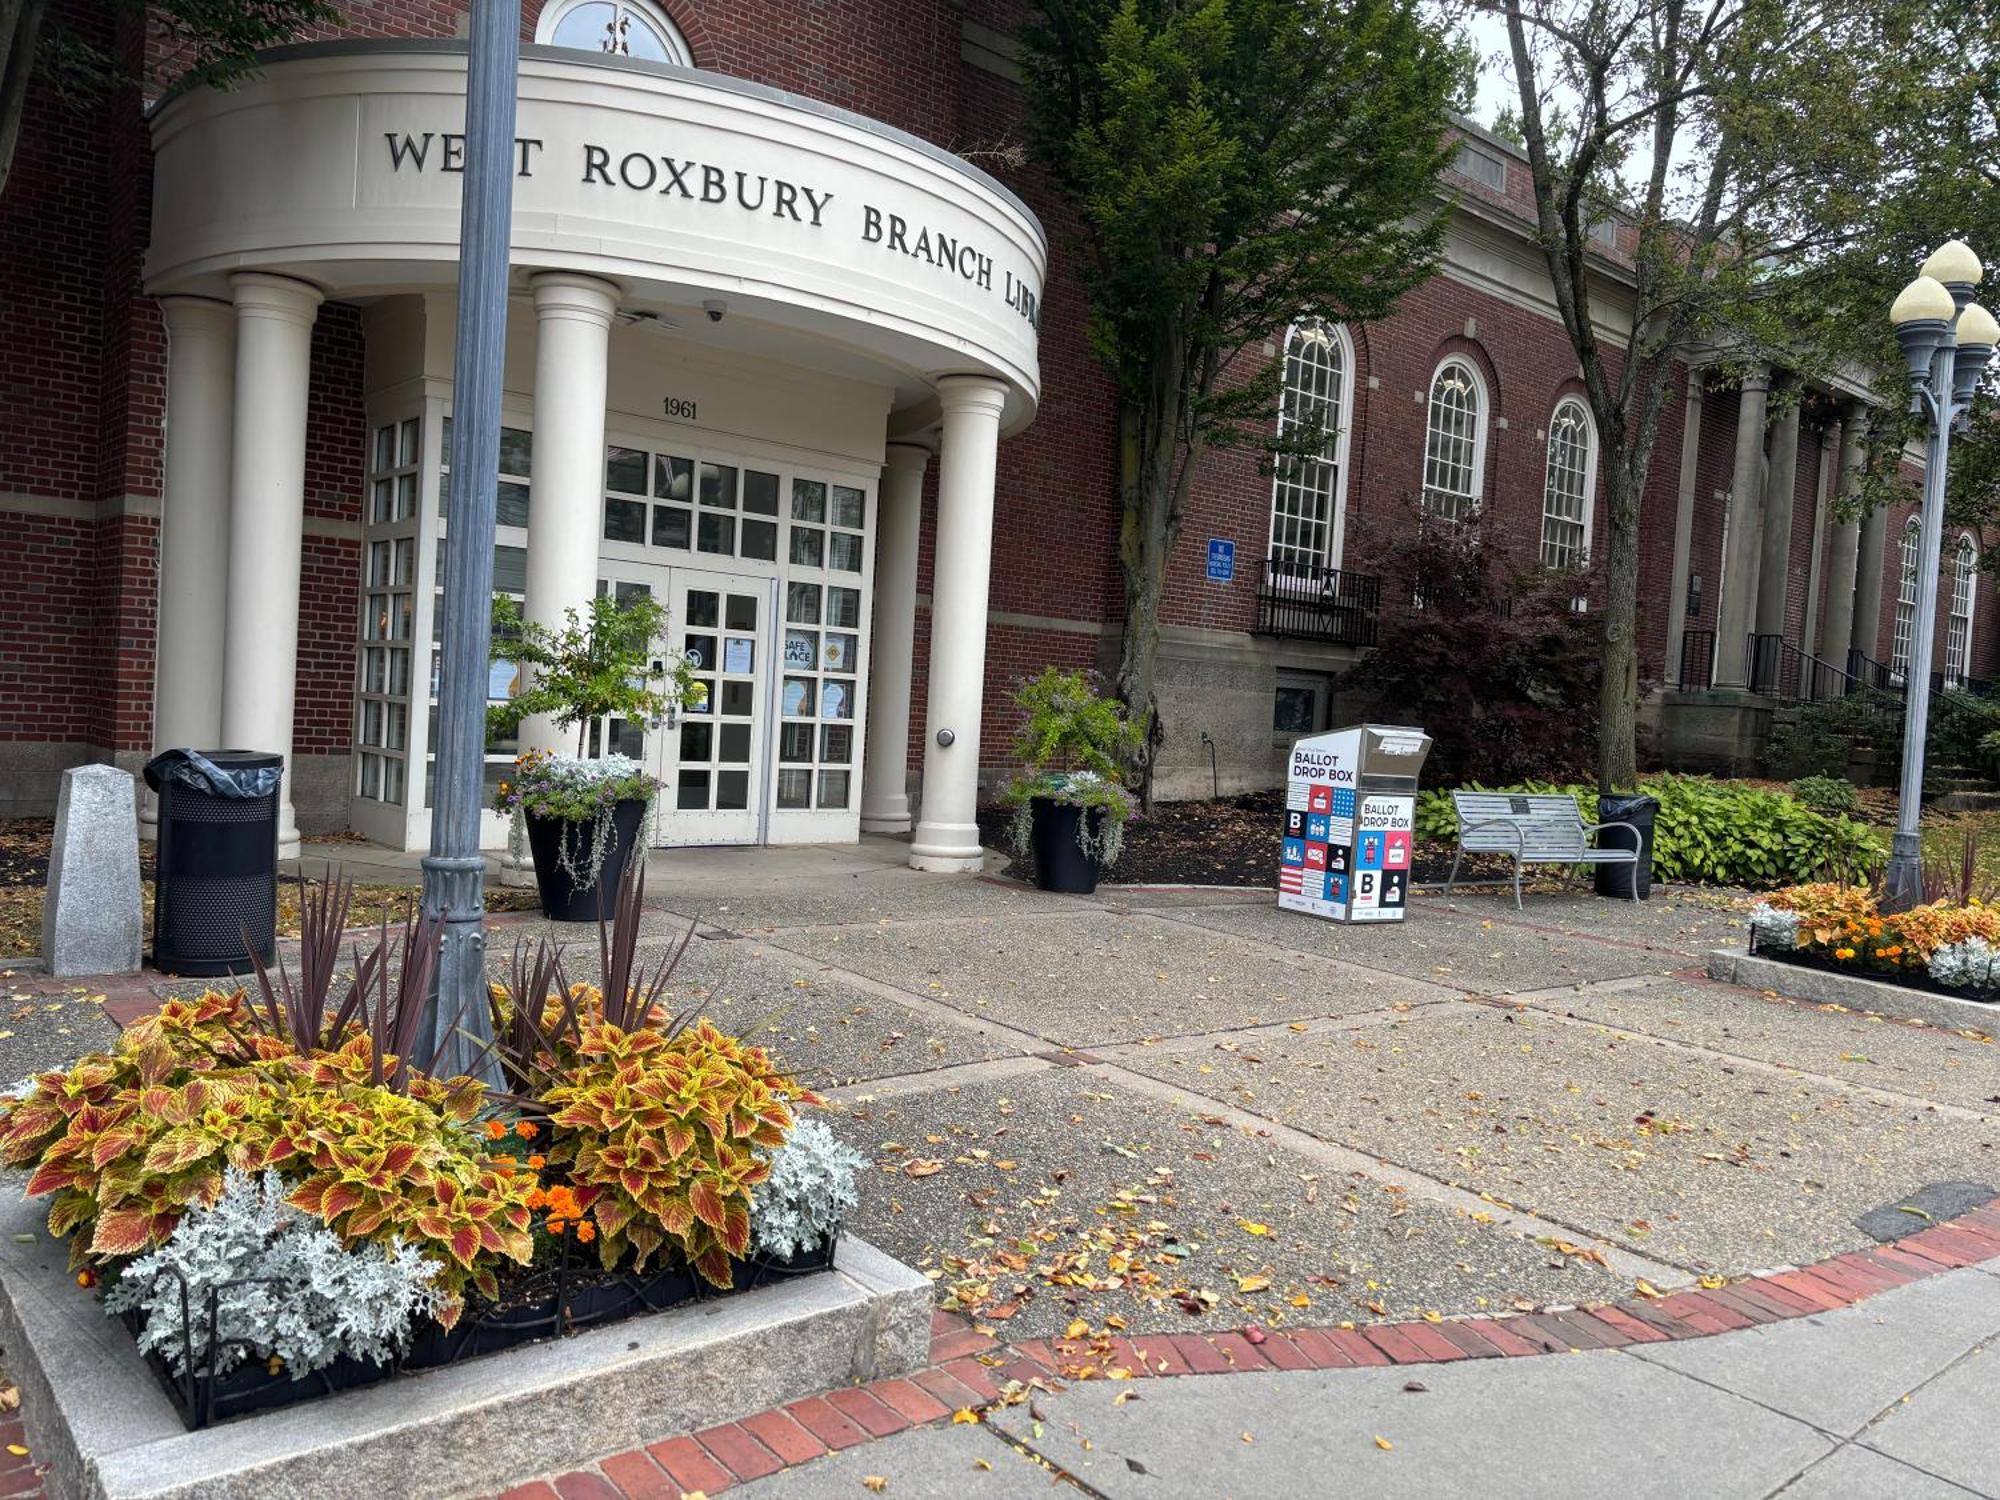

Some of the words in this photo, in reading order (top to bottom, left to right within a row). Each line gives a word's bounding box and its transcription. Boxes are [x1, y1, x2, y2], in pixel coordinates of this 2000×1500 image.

[384, 132, 543, 177] WET
[582, 143, 834, 227] ROXBURY
[861, 204, 993, 291] BRANCH
[663, 396, 696, 420] 1961
[785, 651, 810, 662] LACE
[1295, 752, 1339, 767] BALLOT
[1294, 765, 1326, 779] DROP
[1328, 768, 1354, 782] BOX
[1364, 803, 1399, 816] BALLOT
[1290, 812, 1301, 829] B
[1363, 816, 1389, 828] DROP
[1391, 817, 1409, 828] BOX
[1360, 873, 1374, 894] B
